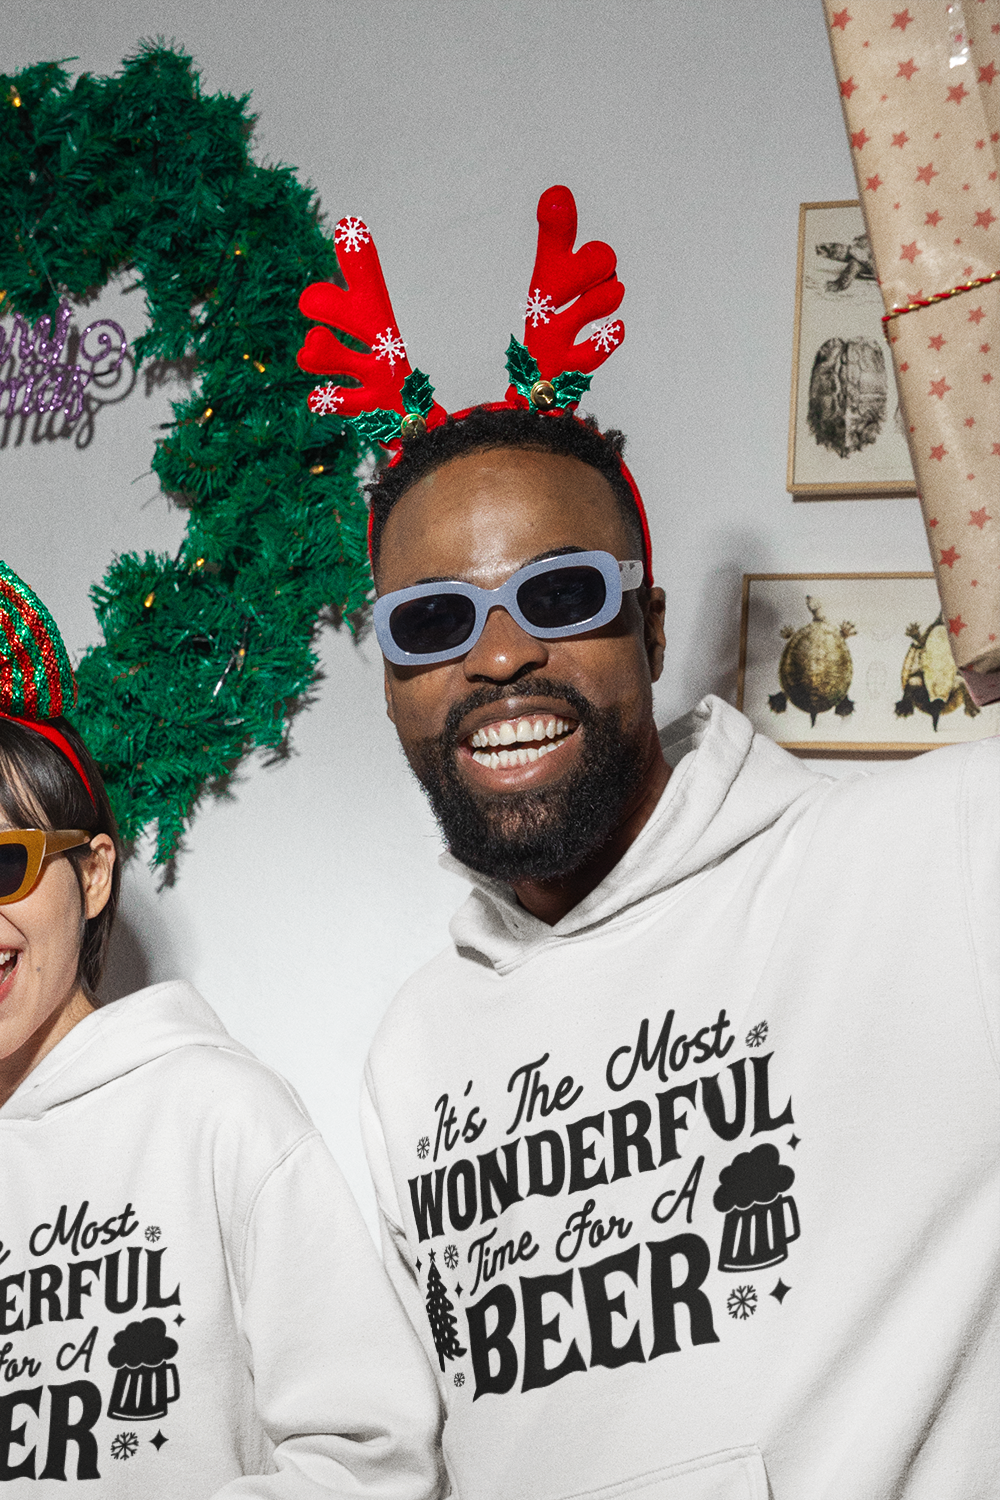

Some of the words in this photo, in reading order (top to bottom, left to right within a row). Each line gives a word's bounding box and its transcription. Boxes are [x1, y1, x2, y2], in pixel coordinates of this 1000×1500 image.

[408, 1051, 795, 1244] WONDERFUL
[432, 1080, 487, 1162] It's
[506, 1052, 584, 1135] The
[605, 1009, 735, 1092] Most
[28, 1200, 140, 1256] Most
[467, 1227, 540, 1296] Time
[555, 1198, 633, 1263] For
[651, 1155, 706, 1224] A
[55, 1325, 99, 1373] A
[465, 1232, 720, 1403] BEER
